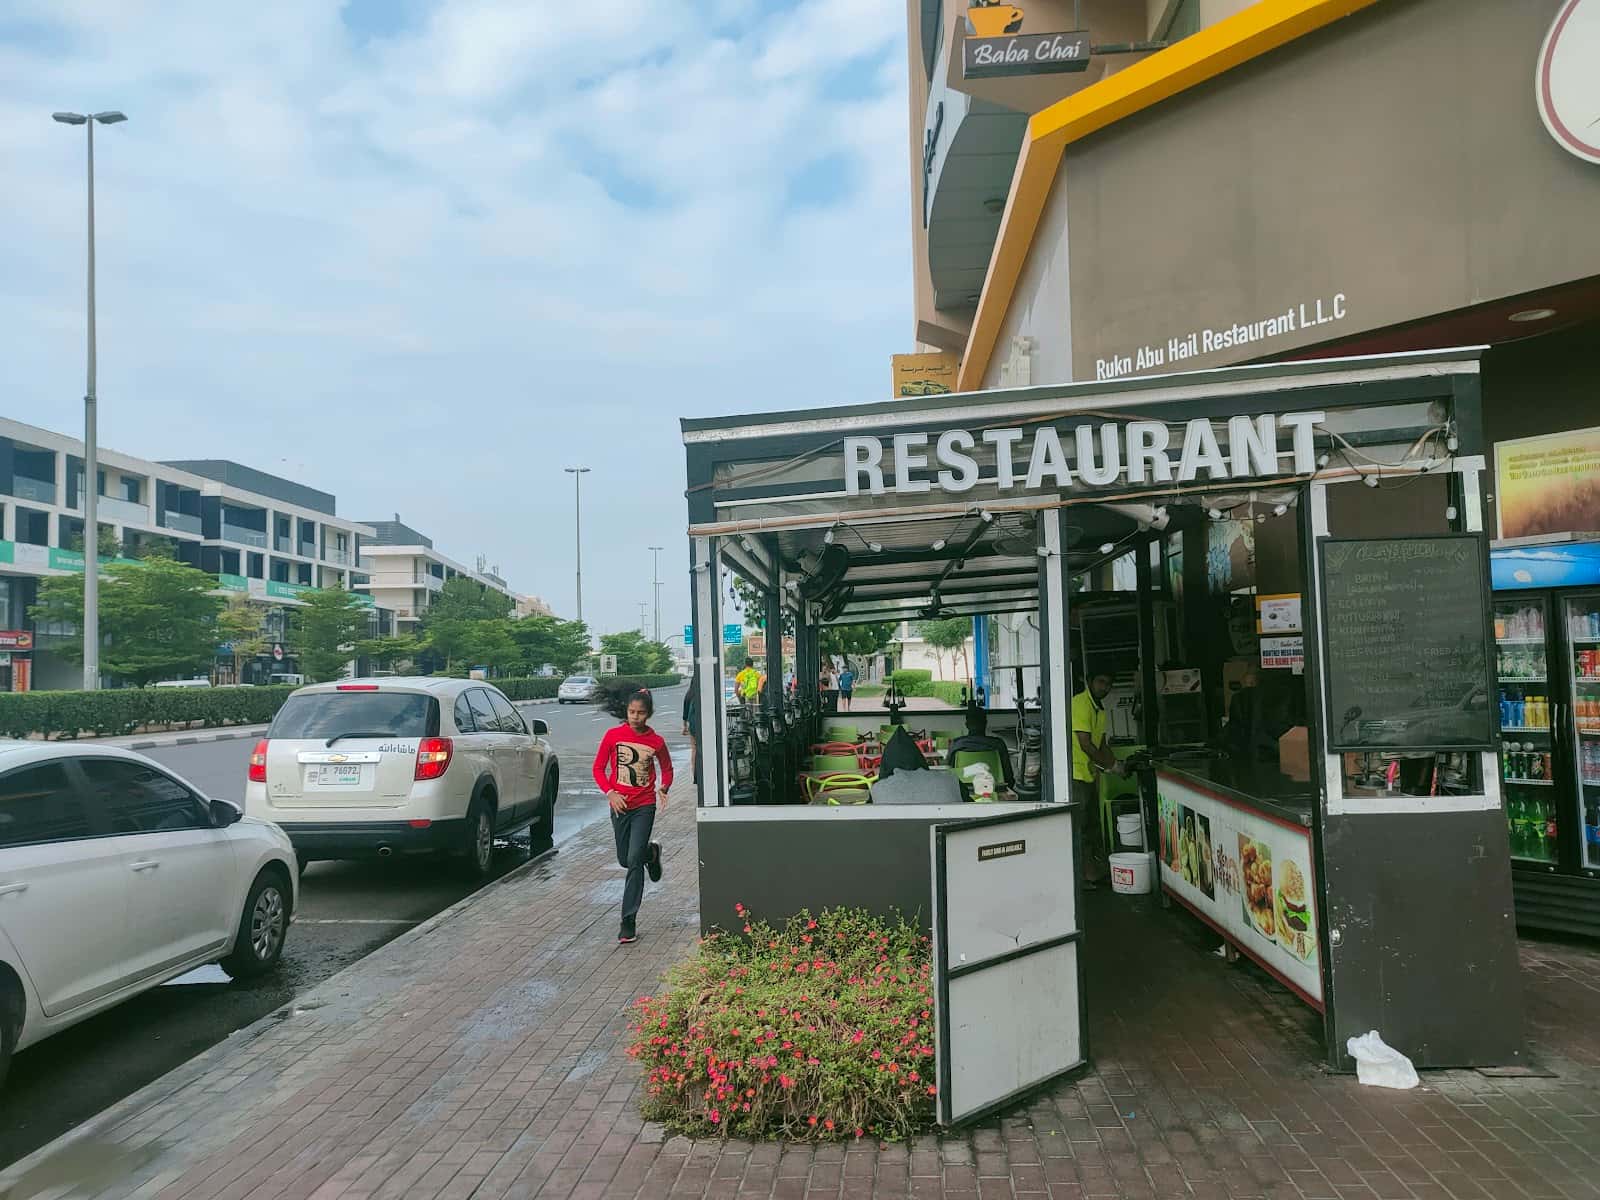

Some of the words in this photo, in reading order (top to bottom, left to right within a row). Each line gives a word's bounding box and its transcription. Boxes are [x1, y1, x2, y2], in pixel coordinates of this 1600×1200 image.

[974, 39, 1029, 64] Baba
[1035, 36, 1082, 60] Chai
[1096, 354, 1132, 380] Rukn
[1135, 345, 1164, 371] Abu
[1168, 332, 1198, 362] Hail
[1202, 308, 1296, 353] Restaurant
[1300, 292, 1346, 329] L.L.C
[843, 410, 1326, 496] RESTAURANT
[616, 744, 639, 787] R
